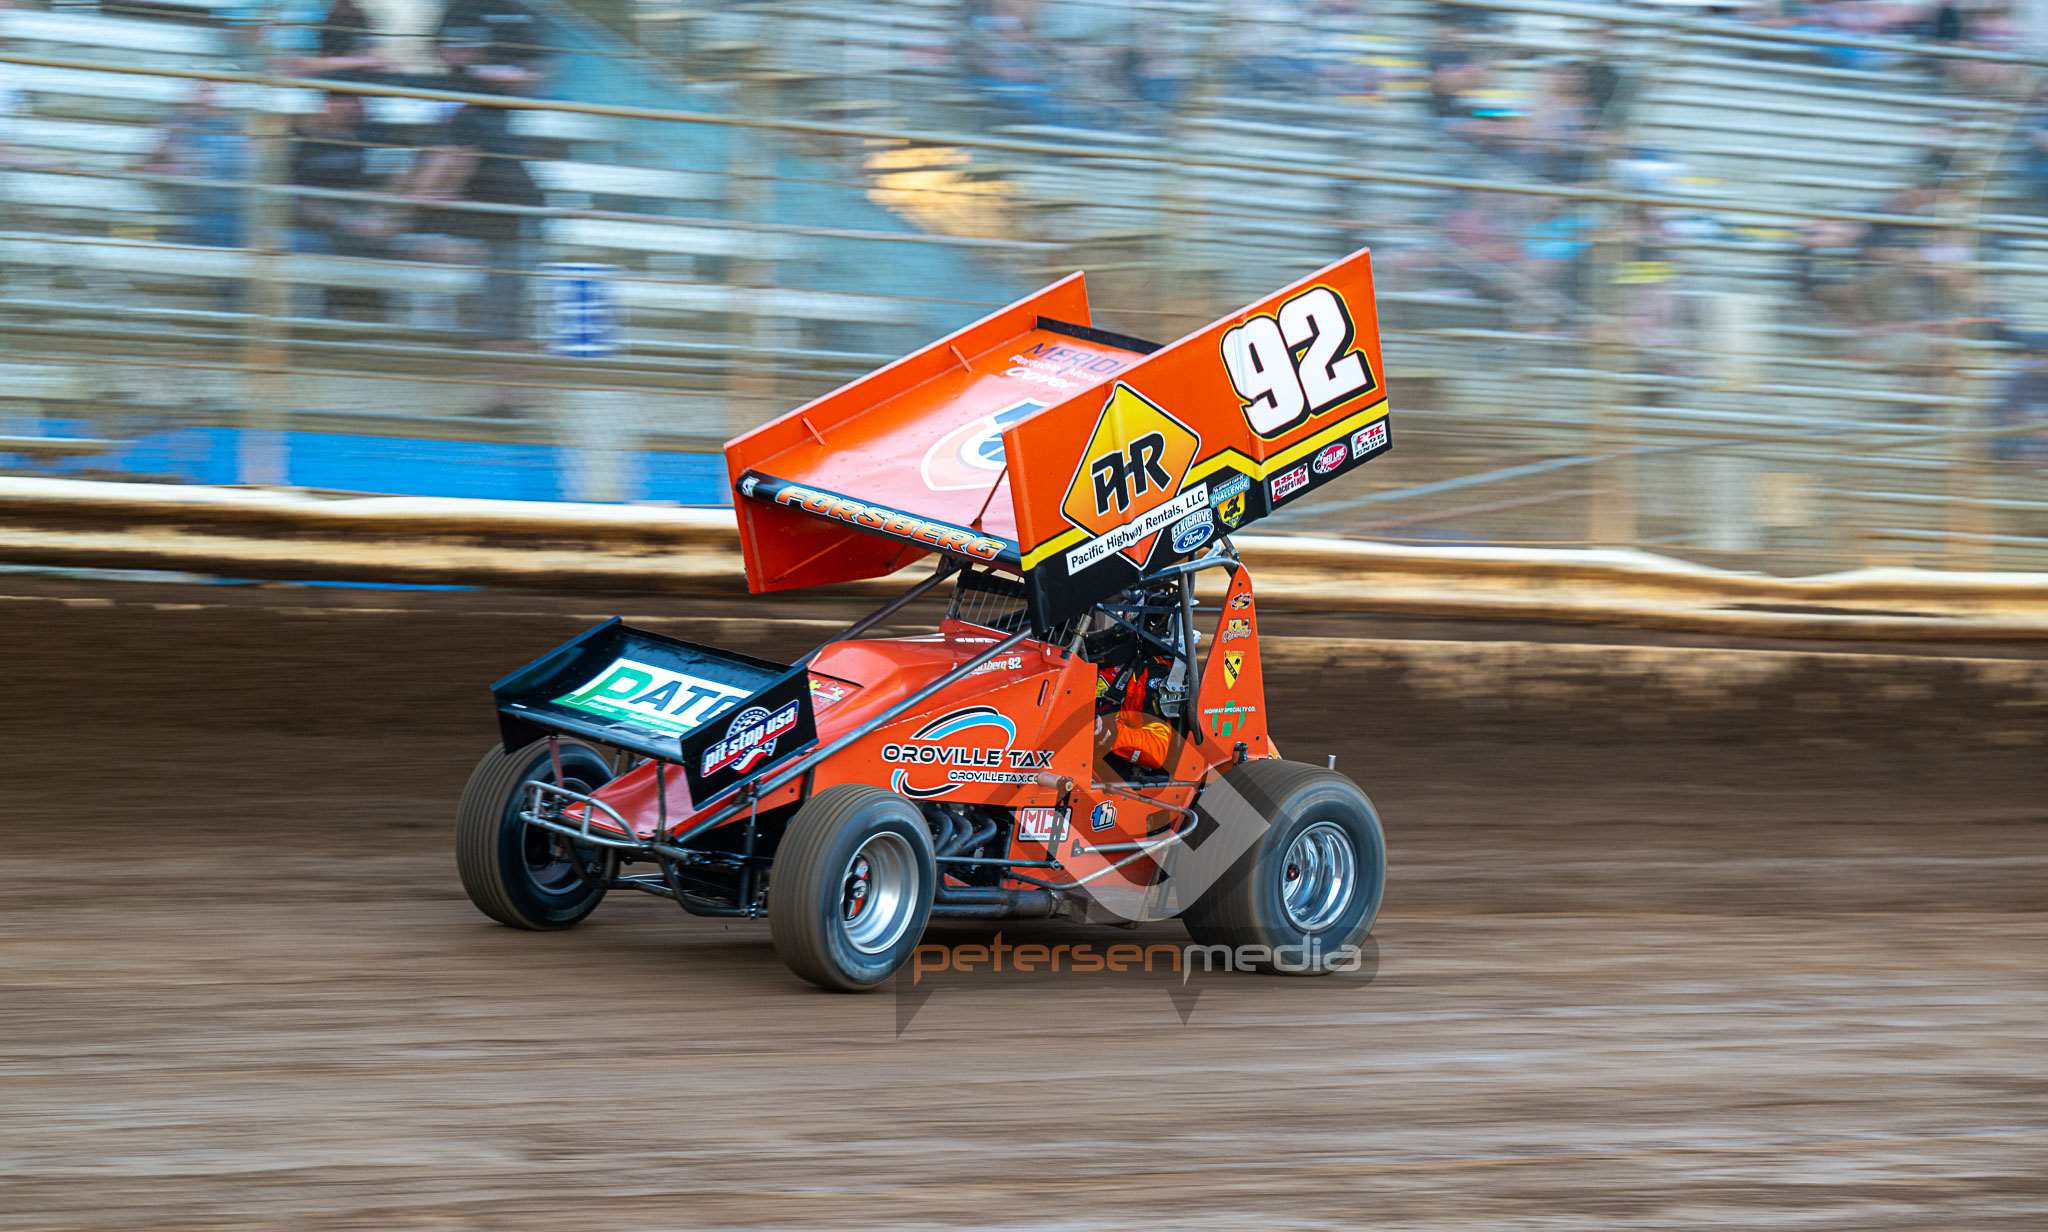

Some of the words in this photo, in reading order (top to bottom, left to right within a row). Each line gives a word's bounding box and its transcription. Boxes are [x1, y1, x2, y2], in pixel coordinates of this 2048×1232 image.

[1022, 342, 1127, 375] MERIDI
[1220, 286, 1377, 439] 92
[1355, 438, 1385, 456] ENDS
[1356, 424, 1384, 444] FK
[1361, 433, 1385, 447] ROD
[1211, 479, 1249, 505] CHALLENGE
[775, 486, 1007, 560] FORSBERG
[1071, 544, 1104, 568] Pacific
[1106, 524, 1143, 550] Highway
[1145, 504, 1185, 530] Rentals,
[1186, 490, 1206, 509] LLC
[1173, 518, 1187, 539] ELK
[1187, 509, 1213, 528] GROVE
[1182, 528, 1205, 548] Ford
[1008, 656, 1023, 670] 92
[704, 743, 727, 774] pit
[727, 725, 764, 758] stop
[766, 706, 795, 732] usa
[883, 744, 1001, 767] OROVILLE
[1007, 750, 1054, 768] TAX
